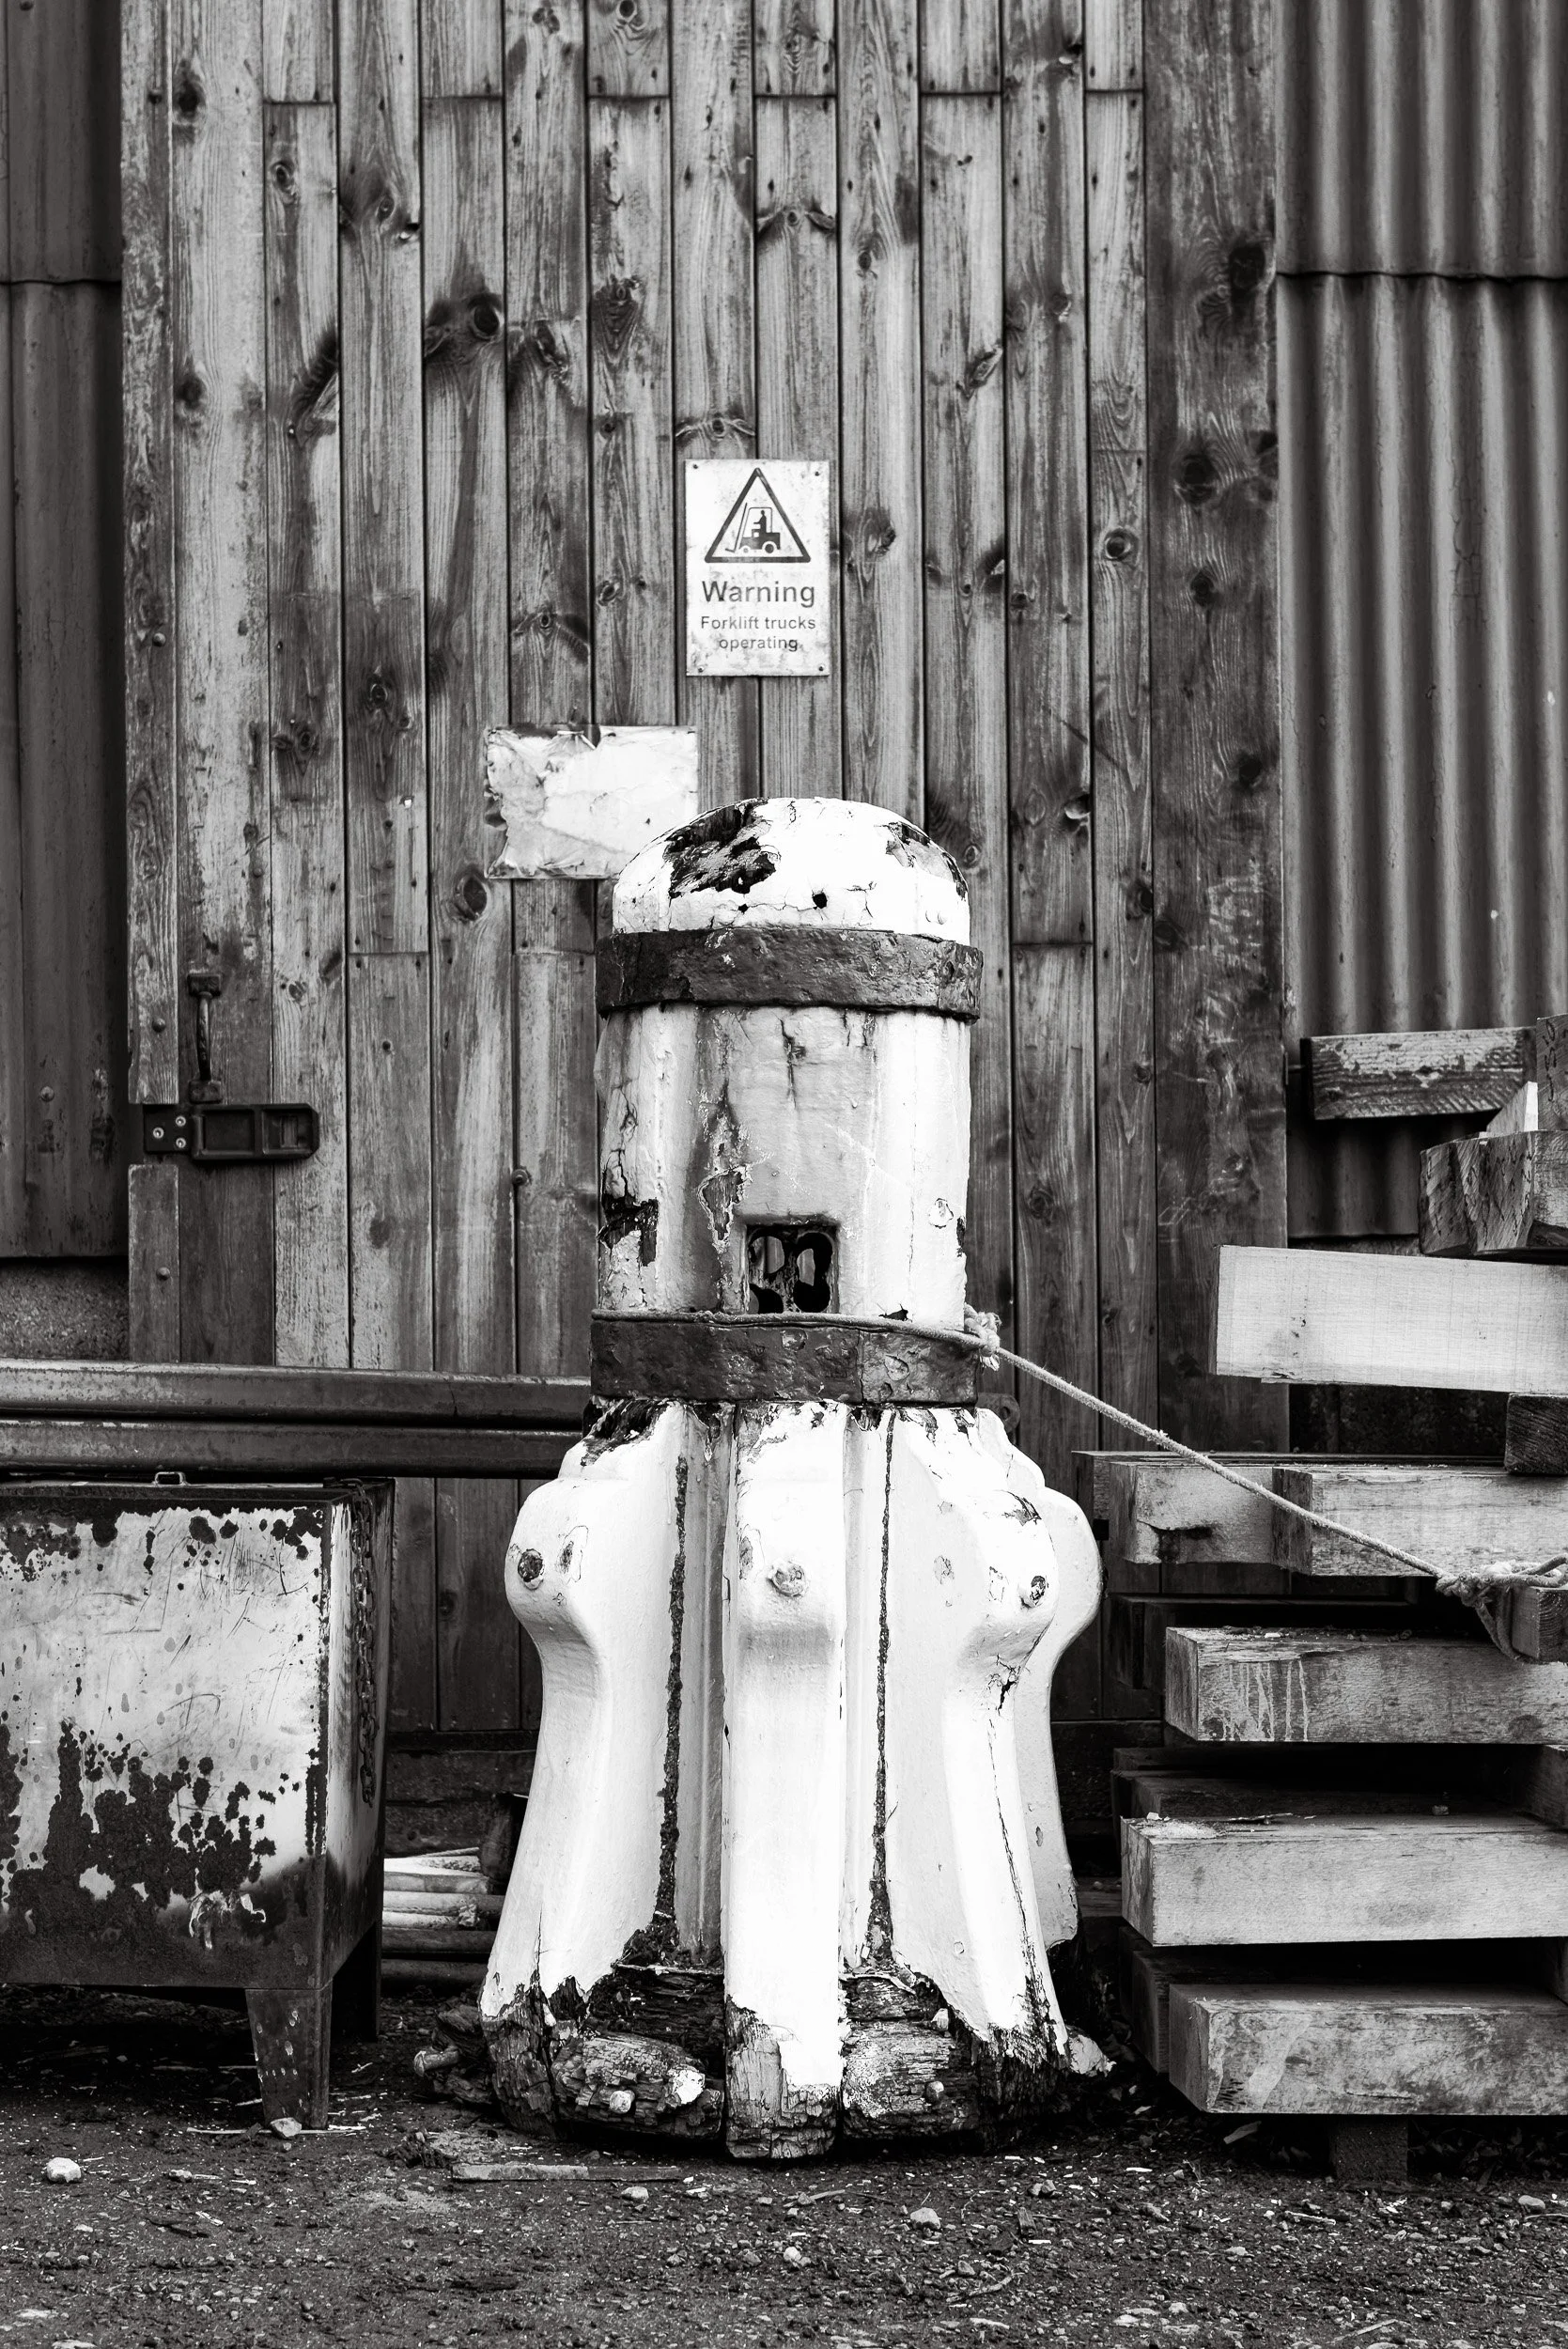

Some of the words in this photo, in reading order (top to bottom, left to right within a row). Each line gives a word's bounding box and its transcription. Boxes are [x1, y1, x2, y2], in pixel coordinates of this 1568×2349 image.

[702, 581, 815, 608] Warning
[701, 615, 759, 630] Forklift
[765, 616, 816, 630] trucks
[719, 637, 799, 652] operating
